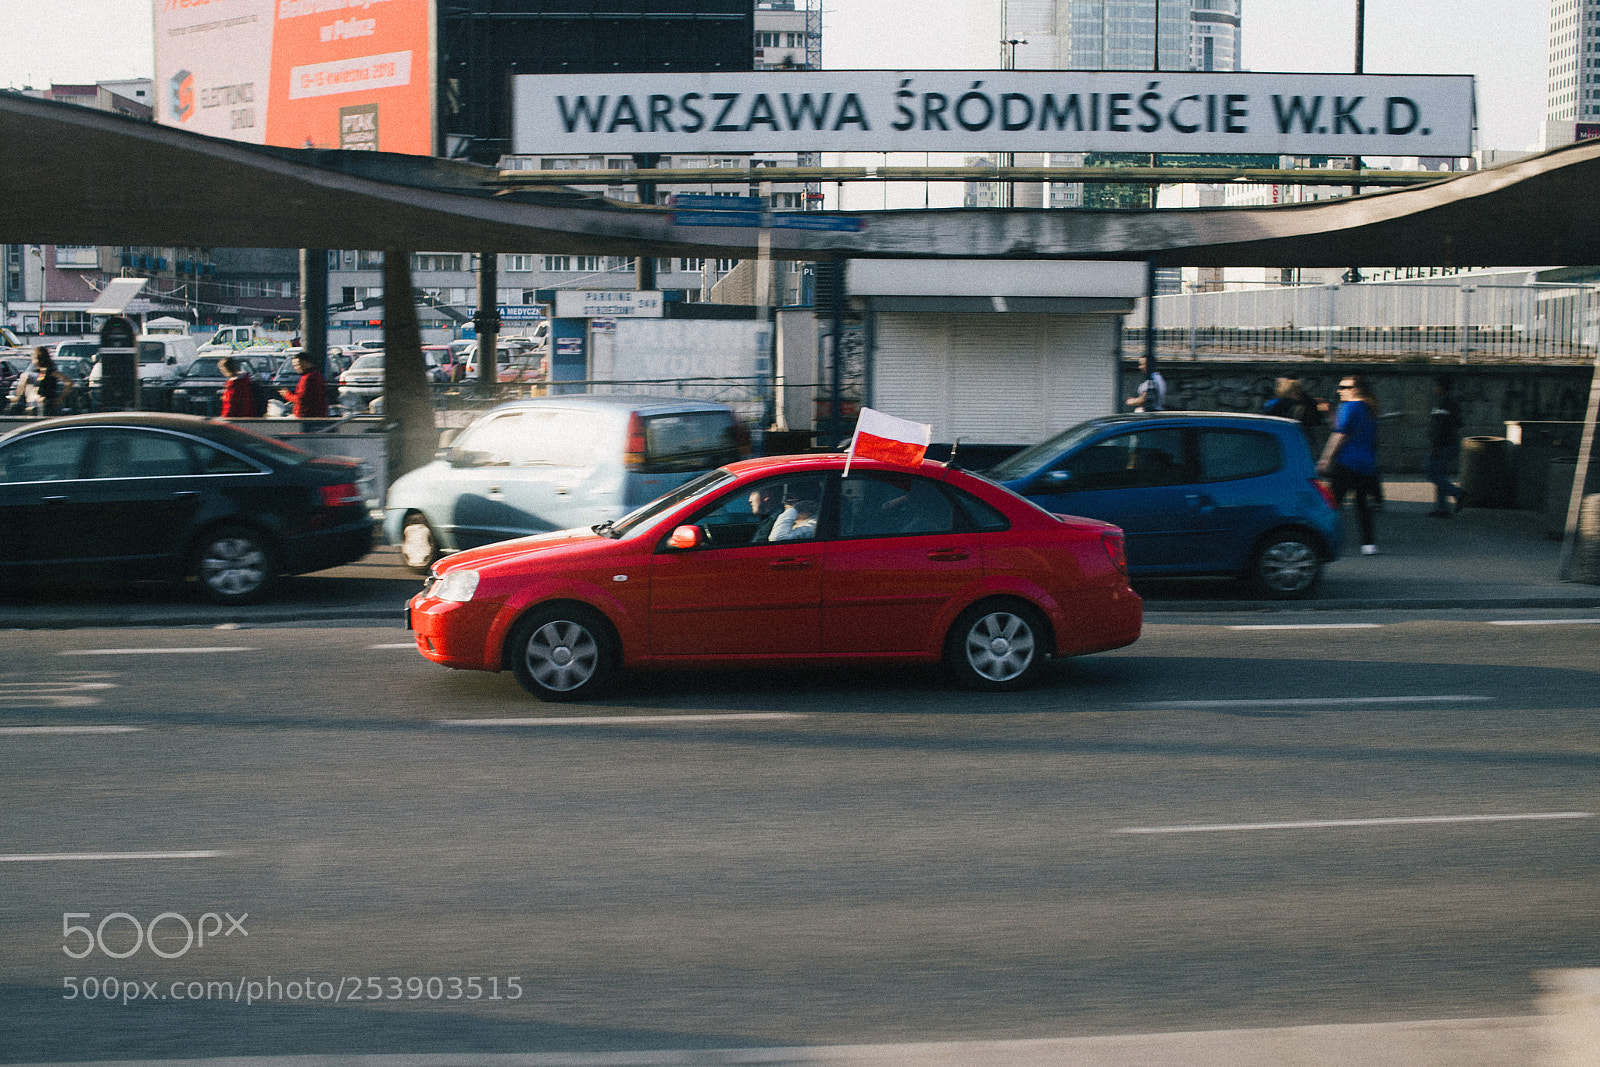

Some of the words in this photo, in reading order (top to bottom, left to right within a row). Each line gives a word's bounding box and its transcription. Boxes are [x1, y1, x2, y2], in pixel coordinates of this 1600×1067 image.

[557, 93, 870, 133] WARSZAWA
[891, 79, 1248, 134] ŚRÓDMIEŚCIE
[1271, 95, 1432, 135] W.K.D.
[507, 308, 542, 316] MEDYCZN
